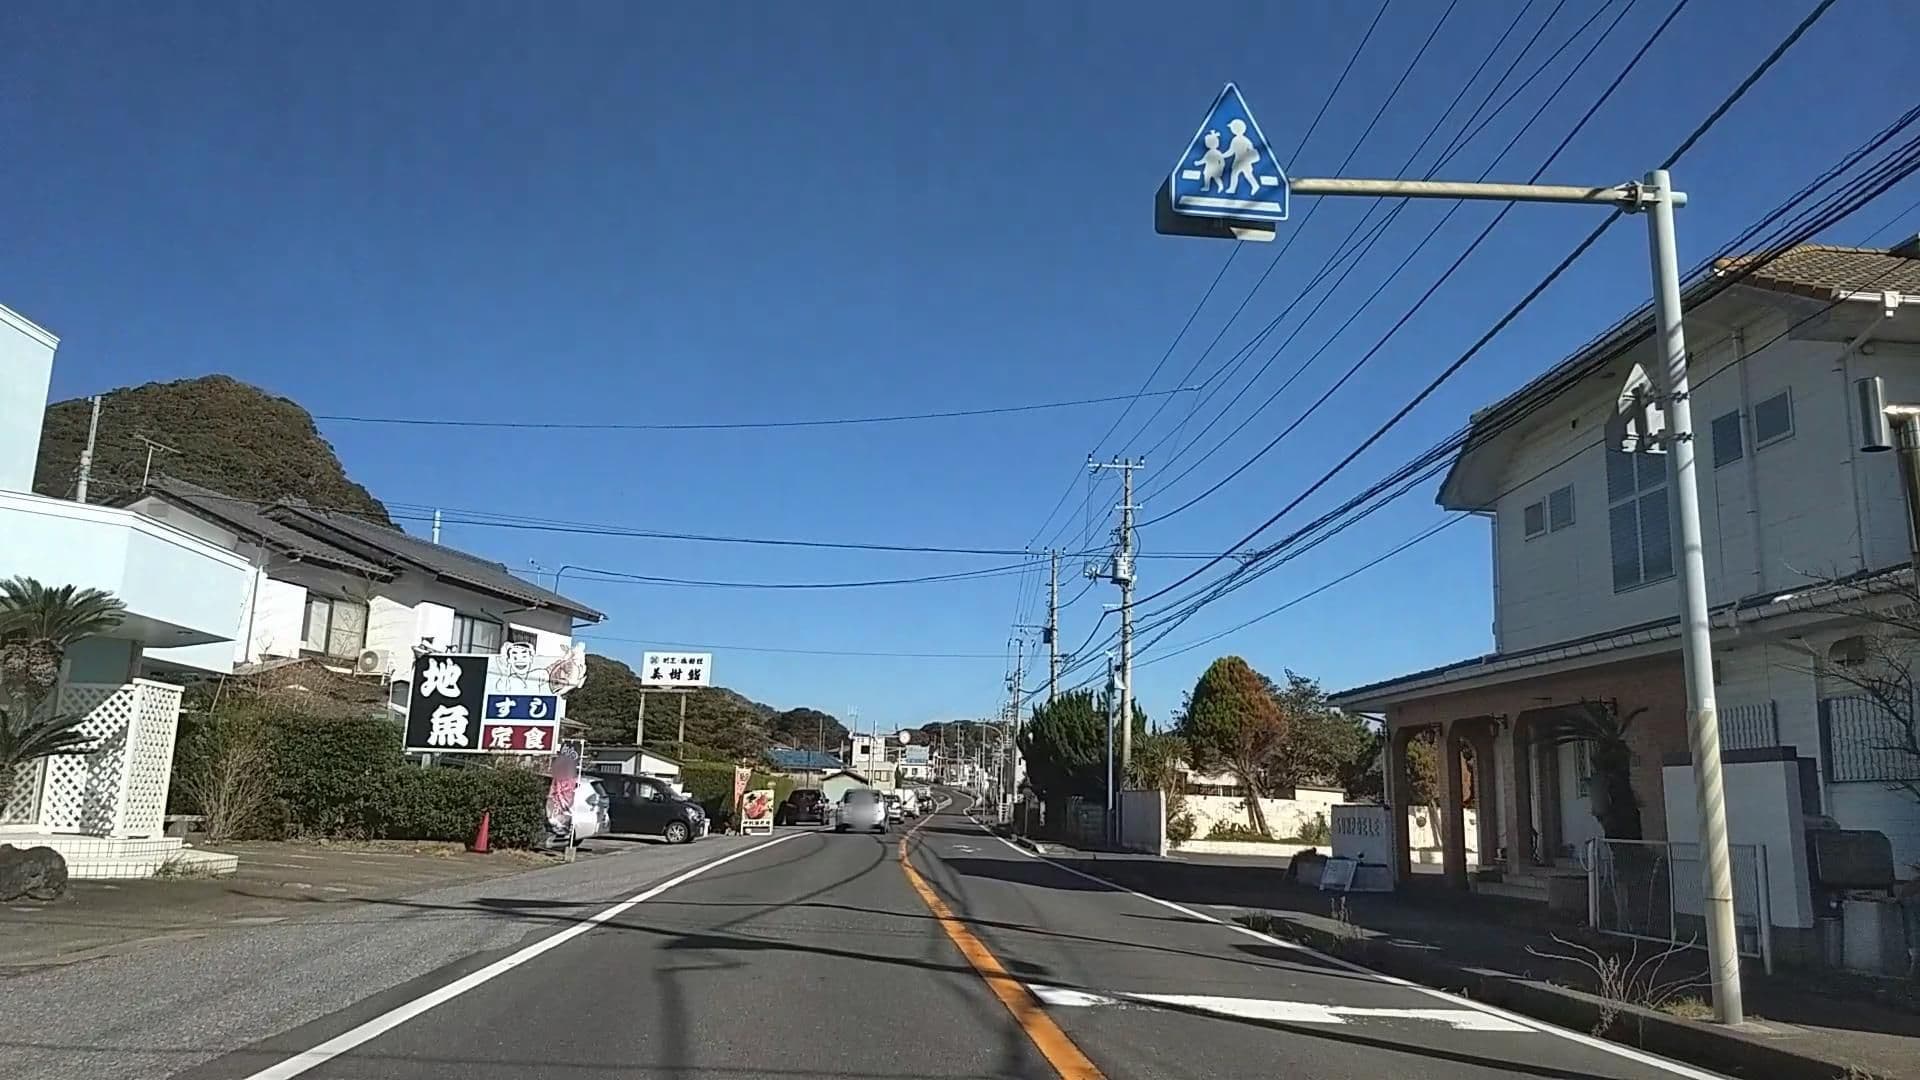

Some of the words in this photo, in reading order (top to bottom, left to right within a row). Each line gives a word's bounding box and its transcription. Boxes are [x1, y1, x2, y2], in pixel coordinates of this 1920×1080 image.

[420, 657, 470, 747] 地魚
[495, 696, 548, 719] すし
[489, 726, 547, 750] 定食
